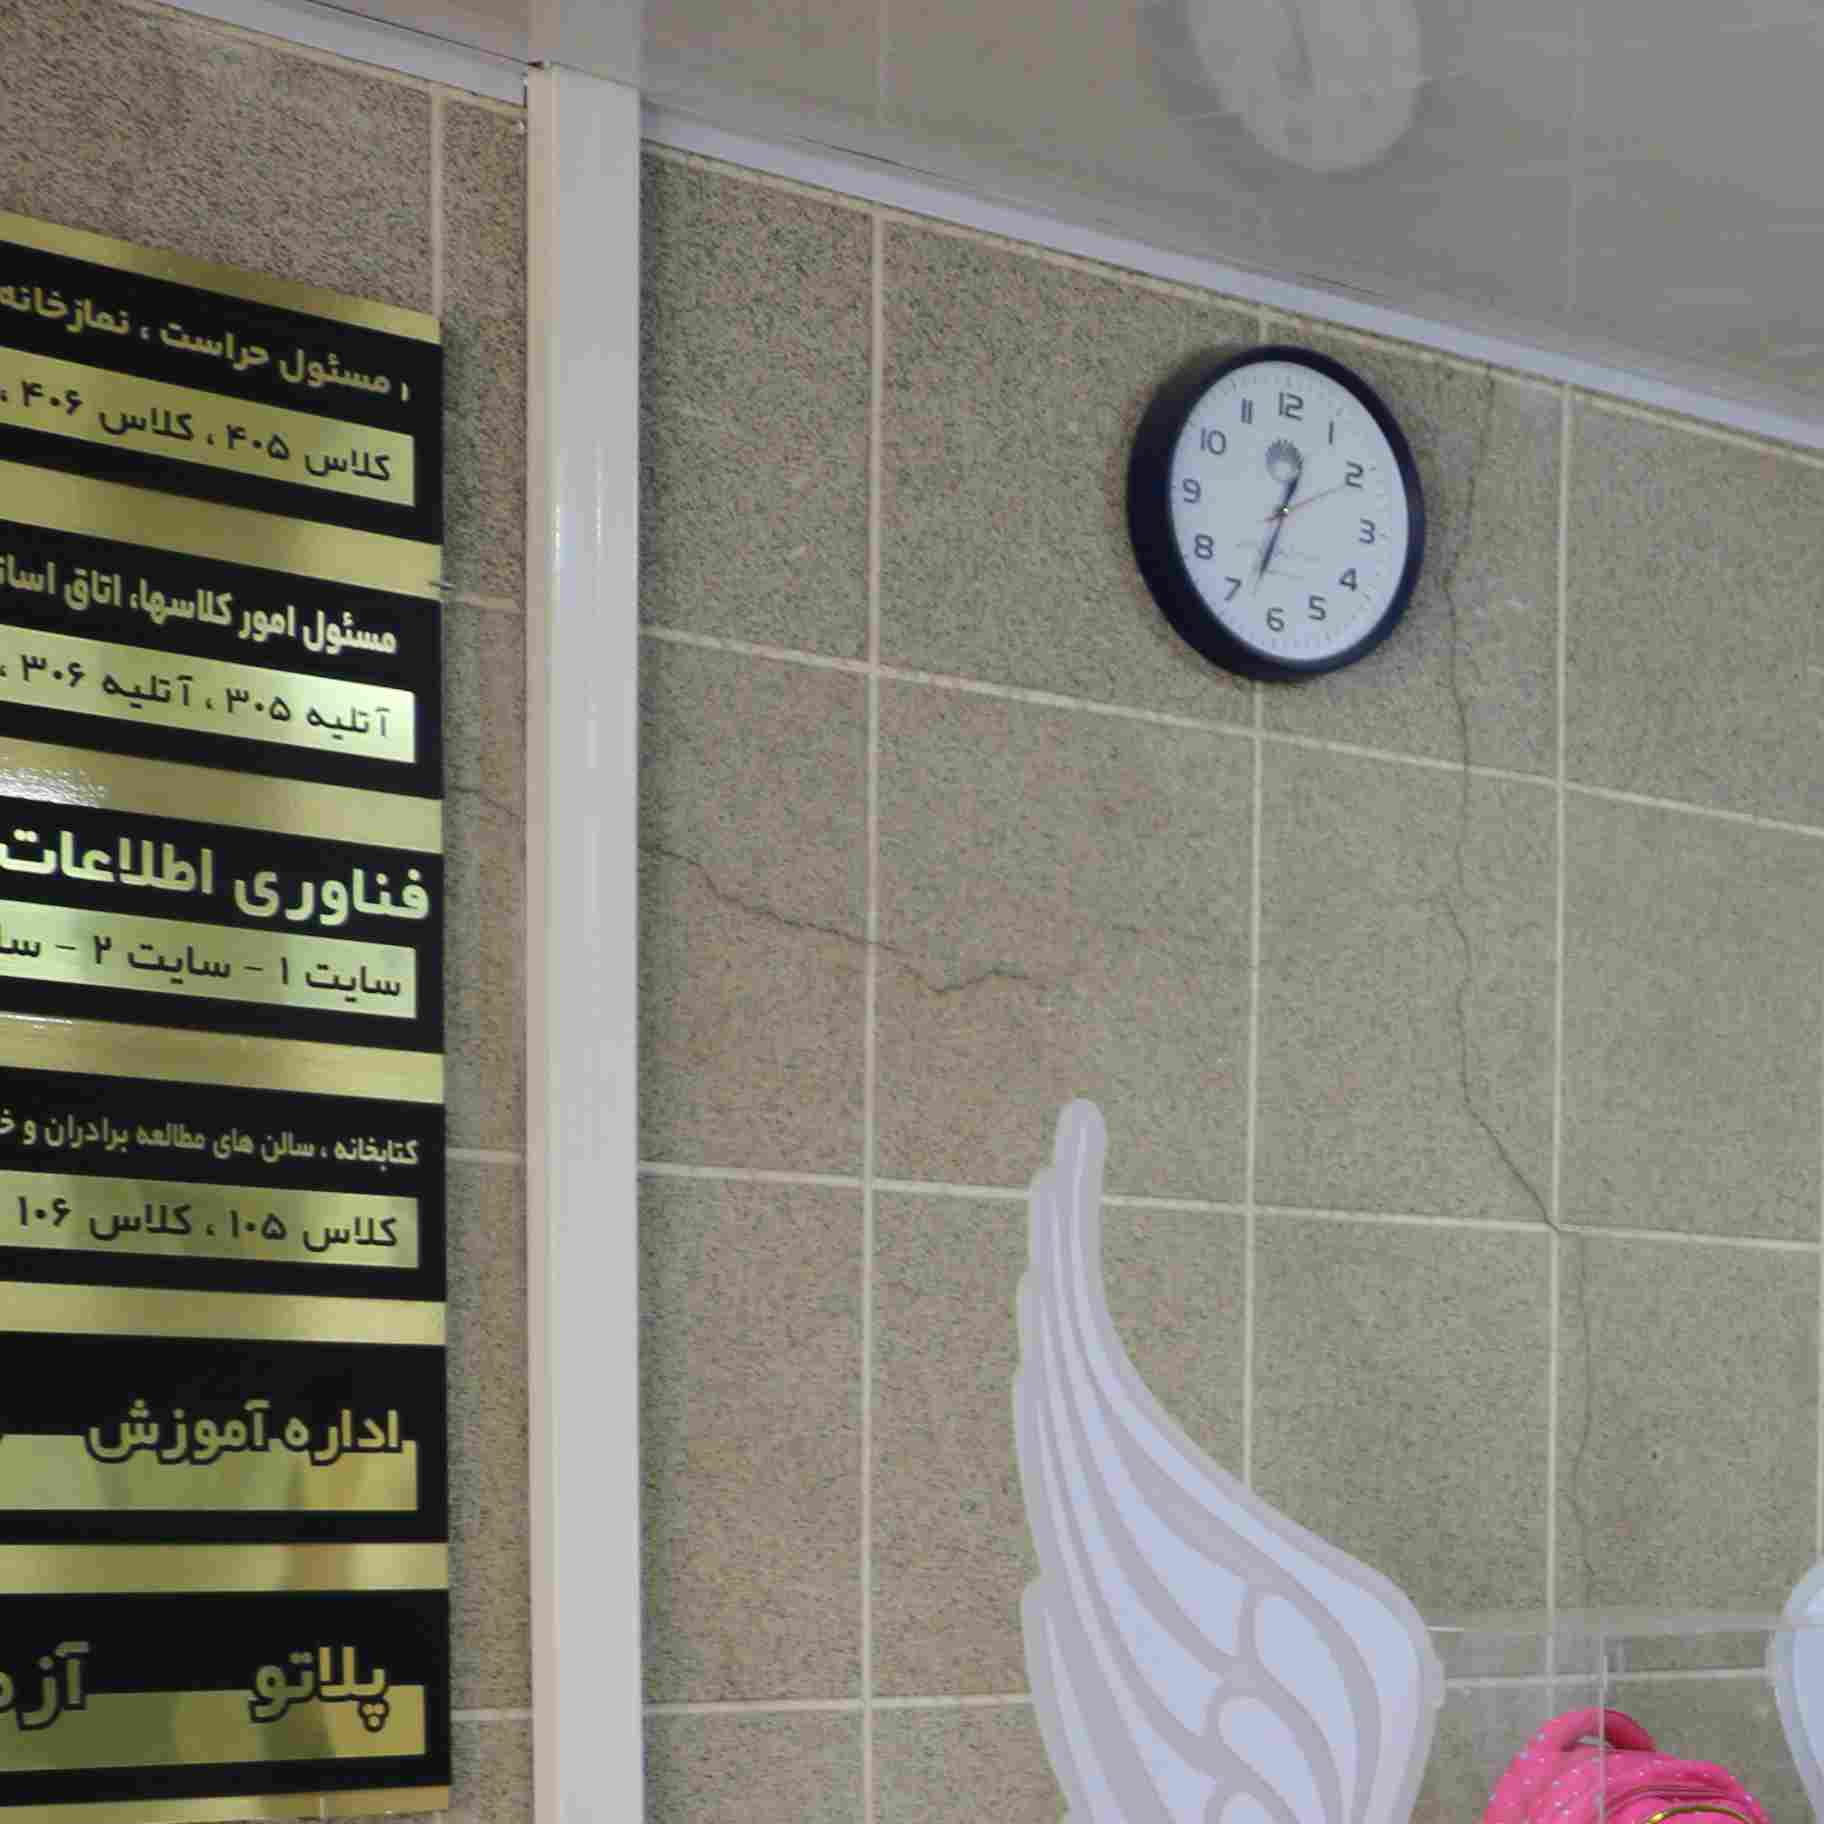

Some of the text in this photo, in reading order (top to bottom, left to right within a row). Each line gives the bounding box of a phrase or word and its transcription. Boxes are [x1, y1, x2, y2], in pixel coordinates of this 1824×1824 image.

[160, 322, 270, 371] حراست
[279, 348, 392, 394] مسئول
[21, 379, 84, 416] ۴۰۶
[1240, 398, 1253, 425] 11
[1278, 391, 1305, 422] 12
[98, 407, 194, 441] کلاس
[226, 424, 290, 460] ۴۰۵
[1200, 429, 1227, 456] 10
[304, 449, 391, 481] کلاس
[1345, 461, 1364, 489] 2
[1182, 478, 1201, 504] 9
[1193, 533, 1215, 561] 8
[1359, 518, 1377, 545] 3
[64, 568, 122, 611] اتاق
[1224, 576, 1242, 602] 7
[1339, 567, 1359, 593] 4
[237, 604, 296, 642] امور
[1265, 607, 1285, 632] 6
[1307, 595, 1327, 622] 5
[302, 609, 398, 656] مسئول
[21, 653, 86, 689] ۳۰۶
[102, 673, 193, 710] آتلیه
[225, 687, 292, 722] ۳۰۵
[306, 706, 391, 740] آتلیه
[0, 828, 430, 927] فناوری اطلاعات
[93, 935, 112, 965] ۲
[127, 944, 231, 983] سایت
[305, 964, 401, 1003] سایت
[22, 1119, 37, 1145] و
[45, 1113, 130, 1153] برادران
[135, 1121, 206, 1150] مطالعه
[213, 1127, 255, 1160] های
[261, 1131, 315, 1163] سالن
[334, 1137, 420, 1172] کتابخانه
[17, 1196, 72, 1227] ۱۰۶
[90, 1202, 192, 1241] کلاس
[229, 1209, 288, 1240] ۱۰۵
[303, 1216, 398, 1253] کلاس
[88, 1398, 399, 1462] اداره آموزش
[250, 1645, 386, 1729] پلاتو
